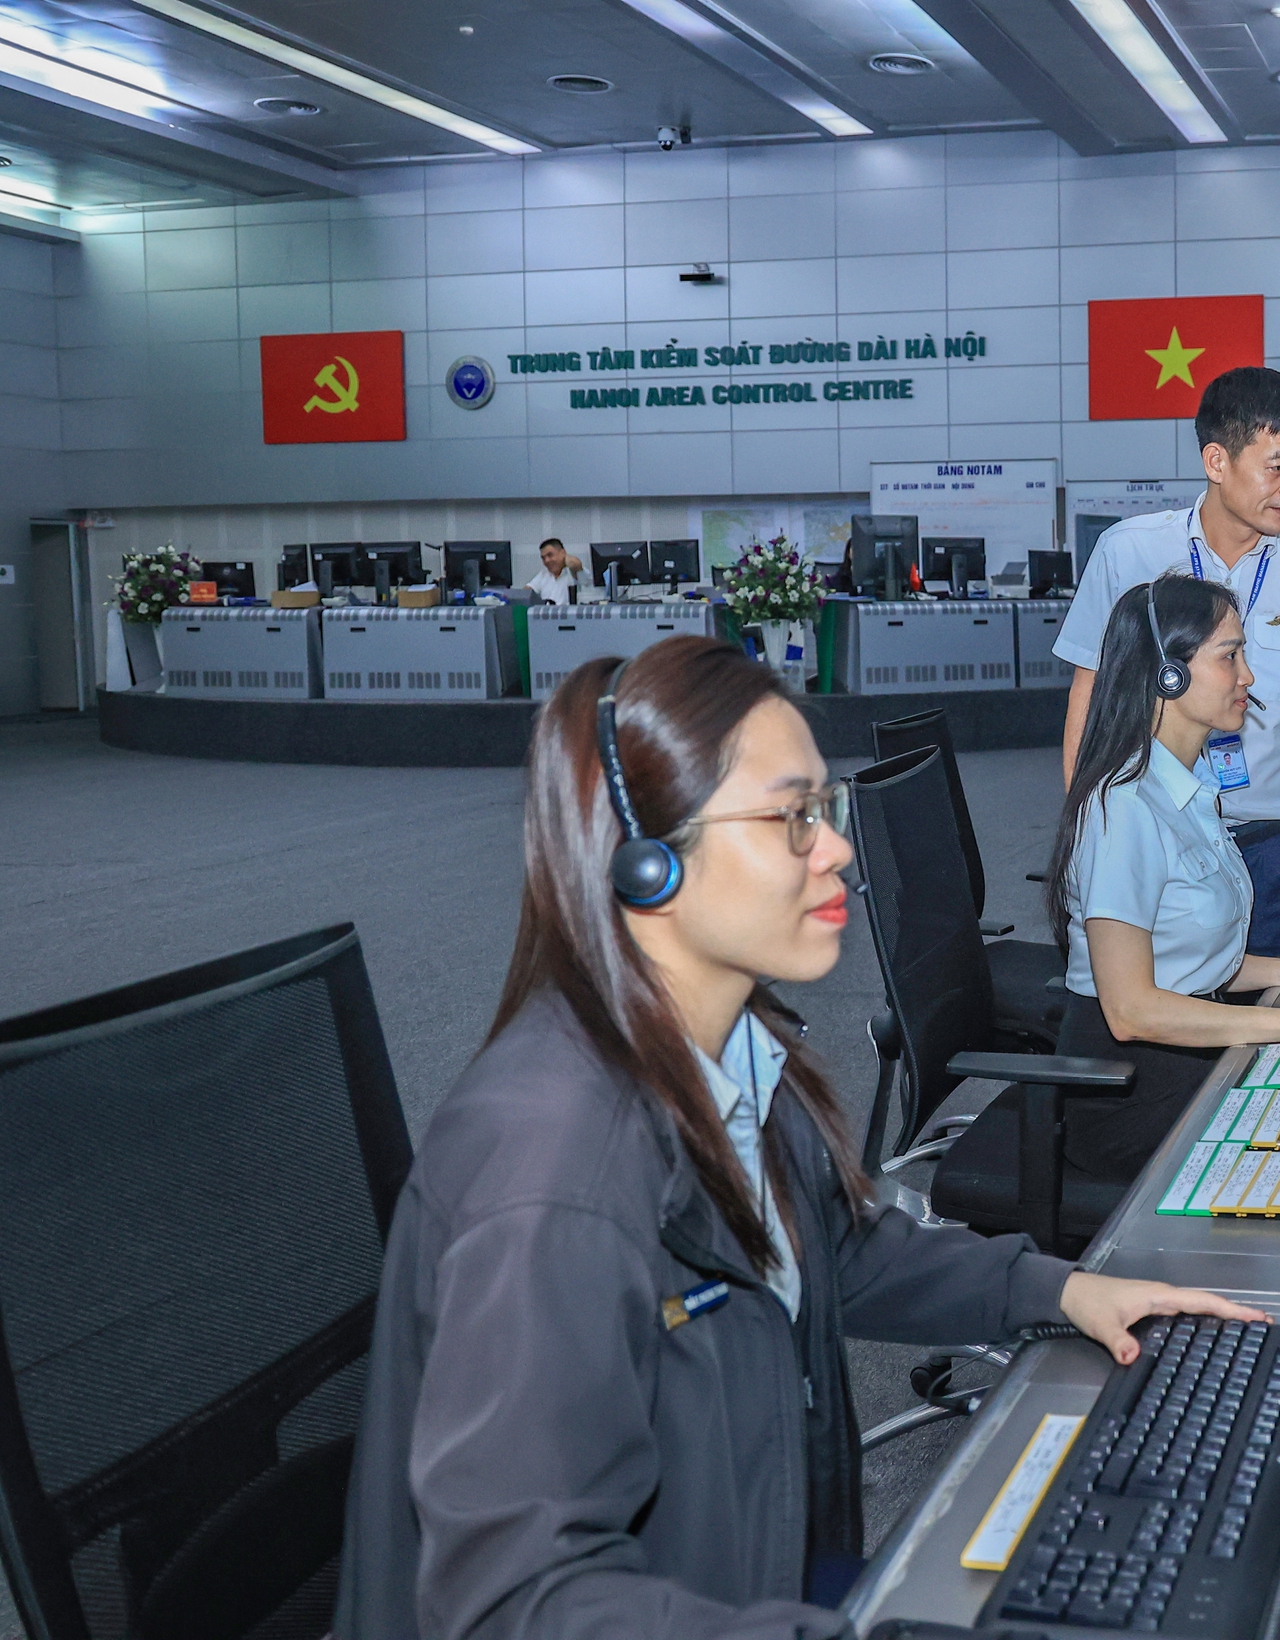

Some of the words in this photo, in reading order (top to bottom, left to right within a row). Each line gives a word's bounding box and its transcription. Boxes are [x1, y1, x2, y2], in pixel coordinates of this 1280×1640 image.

[507, 352, 582, 374] TRUNG
[587, 346, 635, 371] TÂM
[640, 338, 698, 369] KIỂM
[704, 340, 763, 367] SOÁT
[768, 336, 851, 364] ĐƯỜNG
[857, 334, 898, 361] DÀI
[905, 332, 938, 359] HÀ
[944, 331, 986, 362] NỘI
[569, 387, 641, 409] HANOI
[646, 386, 706, 407] AREA
[711, 382, 817, 405] CONTROL
[823, 378, 914, 402] CENTRE
[966, 464, 1003, 476] NOTAM
